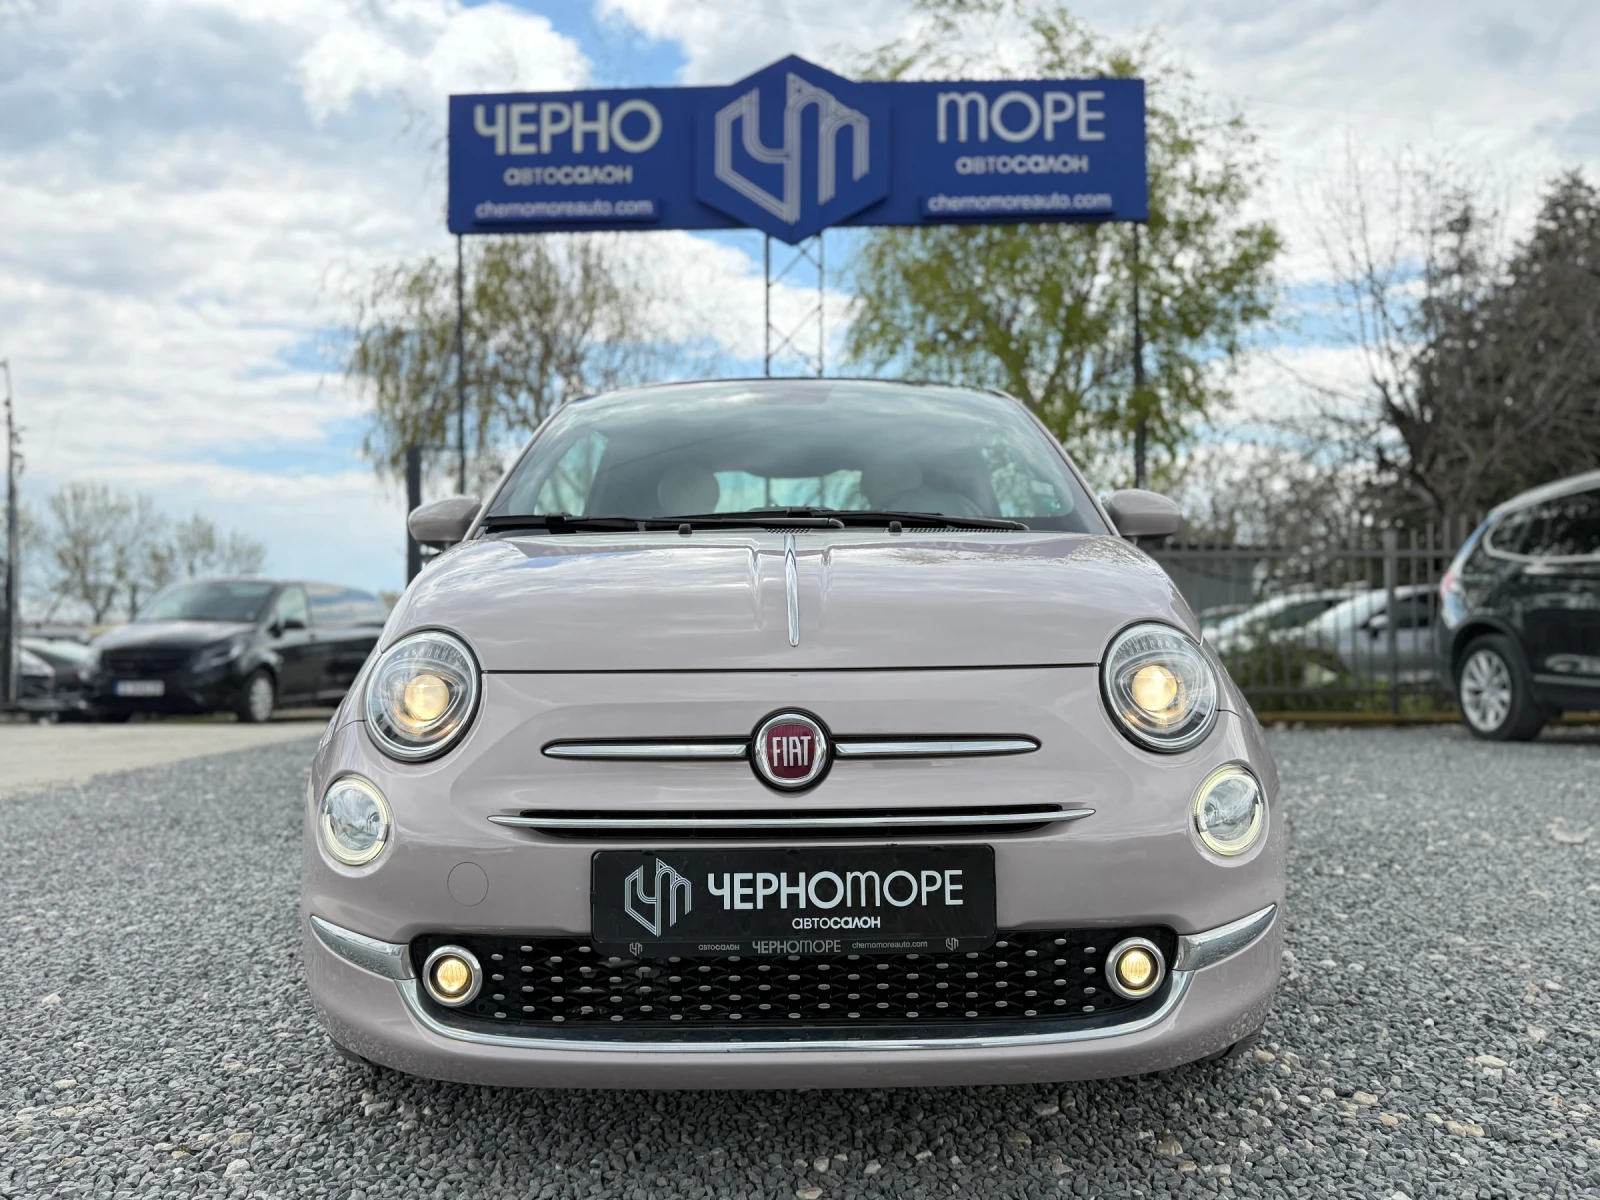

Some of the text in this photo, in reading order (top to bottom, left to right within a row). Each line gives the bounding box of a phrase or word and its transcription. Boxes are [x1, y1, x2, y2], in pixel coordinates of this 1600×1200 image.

[473, 99, 663, 155] ЧЕРНО
[936, 90, 1106, 143] МОРЕ
[772, 735, 812, 767] FIAT
[707, 869, 964, 910] ЧЕРНОМОРЕ
[791, 915, 881, 930] автосалон
[752, 939, 842, 955] ЧЕРНОМОРЕ
[851, 940, 928, 950] chernomoreauto.com
